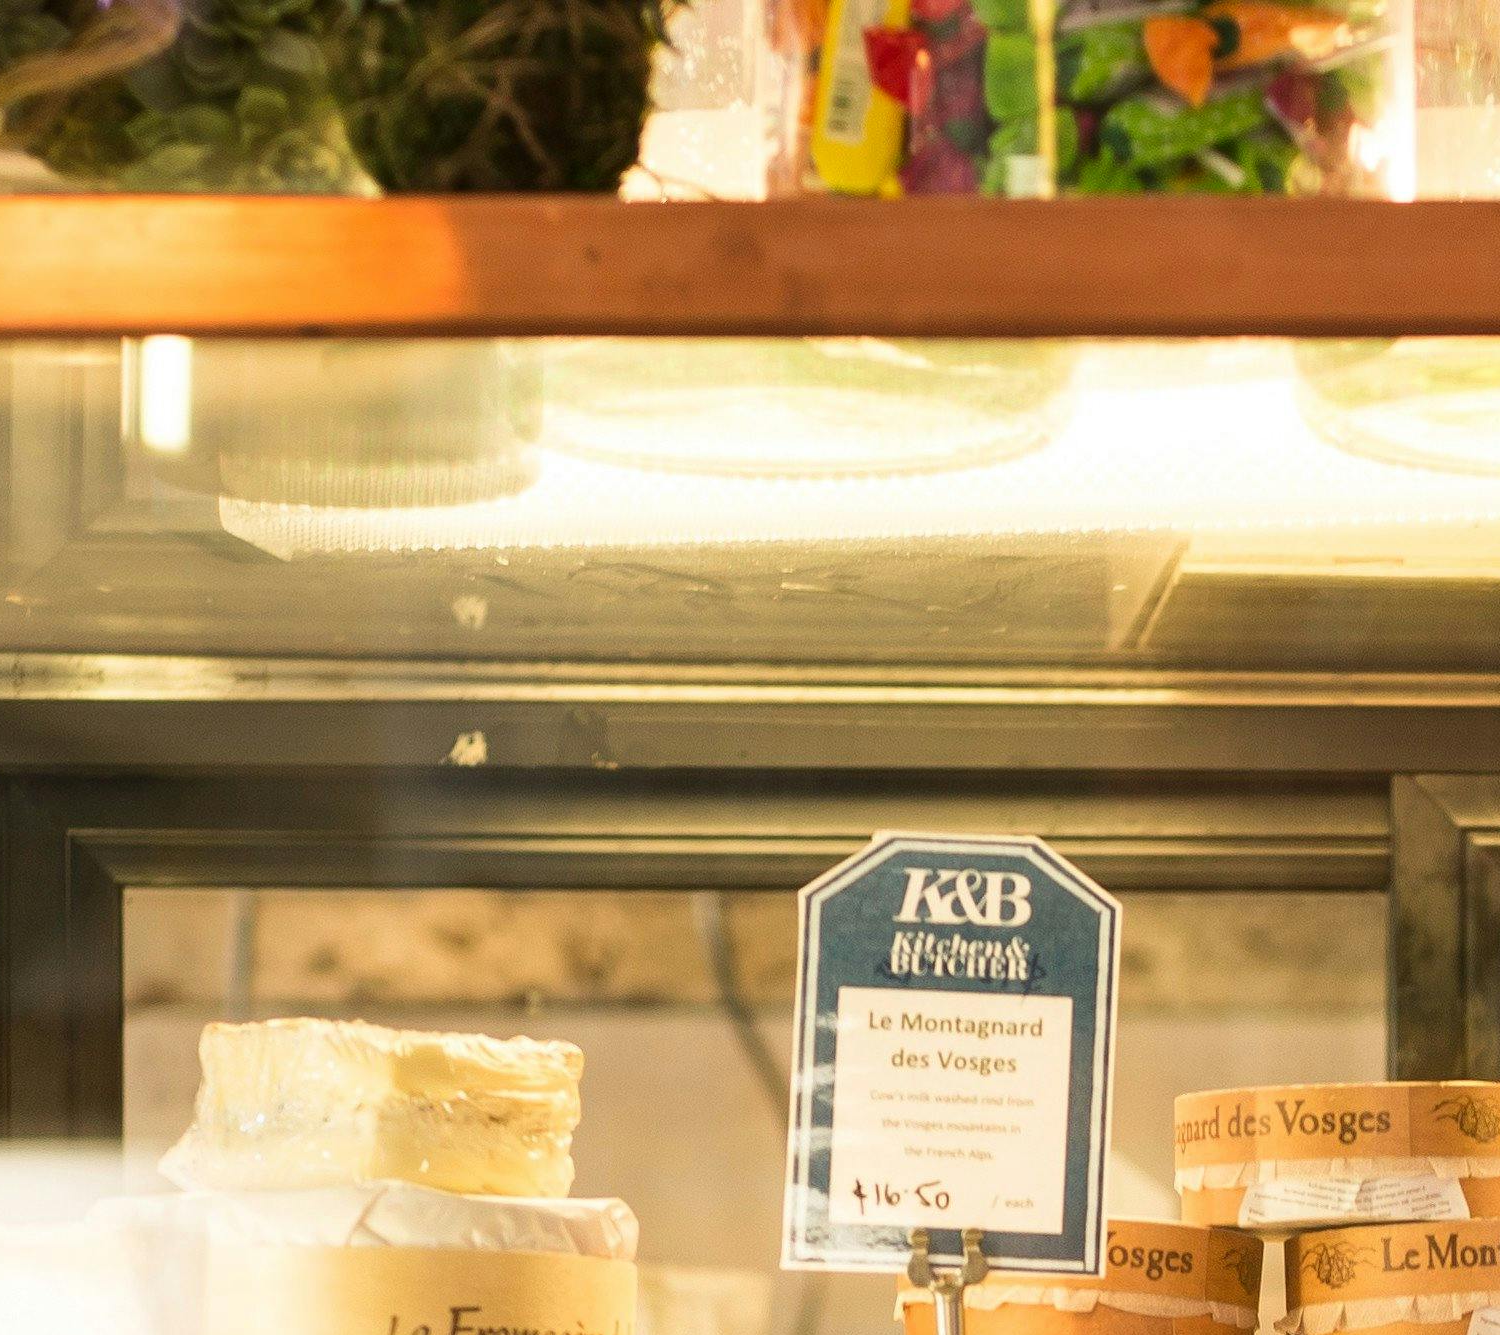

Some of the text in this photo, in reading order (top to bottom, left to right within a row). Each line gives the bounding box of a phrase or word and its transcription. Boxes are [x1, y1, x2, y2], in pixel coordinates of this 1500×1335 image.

[893, 866, 1032, 928] K&B
[868, 1011, 1043, 1038] Le Montagnard
[891, 1049, 1017, 1076] des Vosges
[1227, 1101, 1391, 1145] des Vosges
[1381, 1238, 1421, 1273] Le
